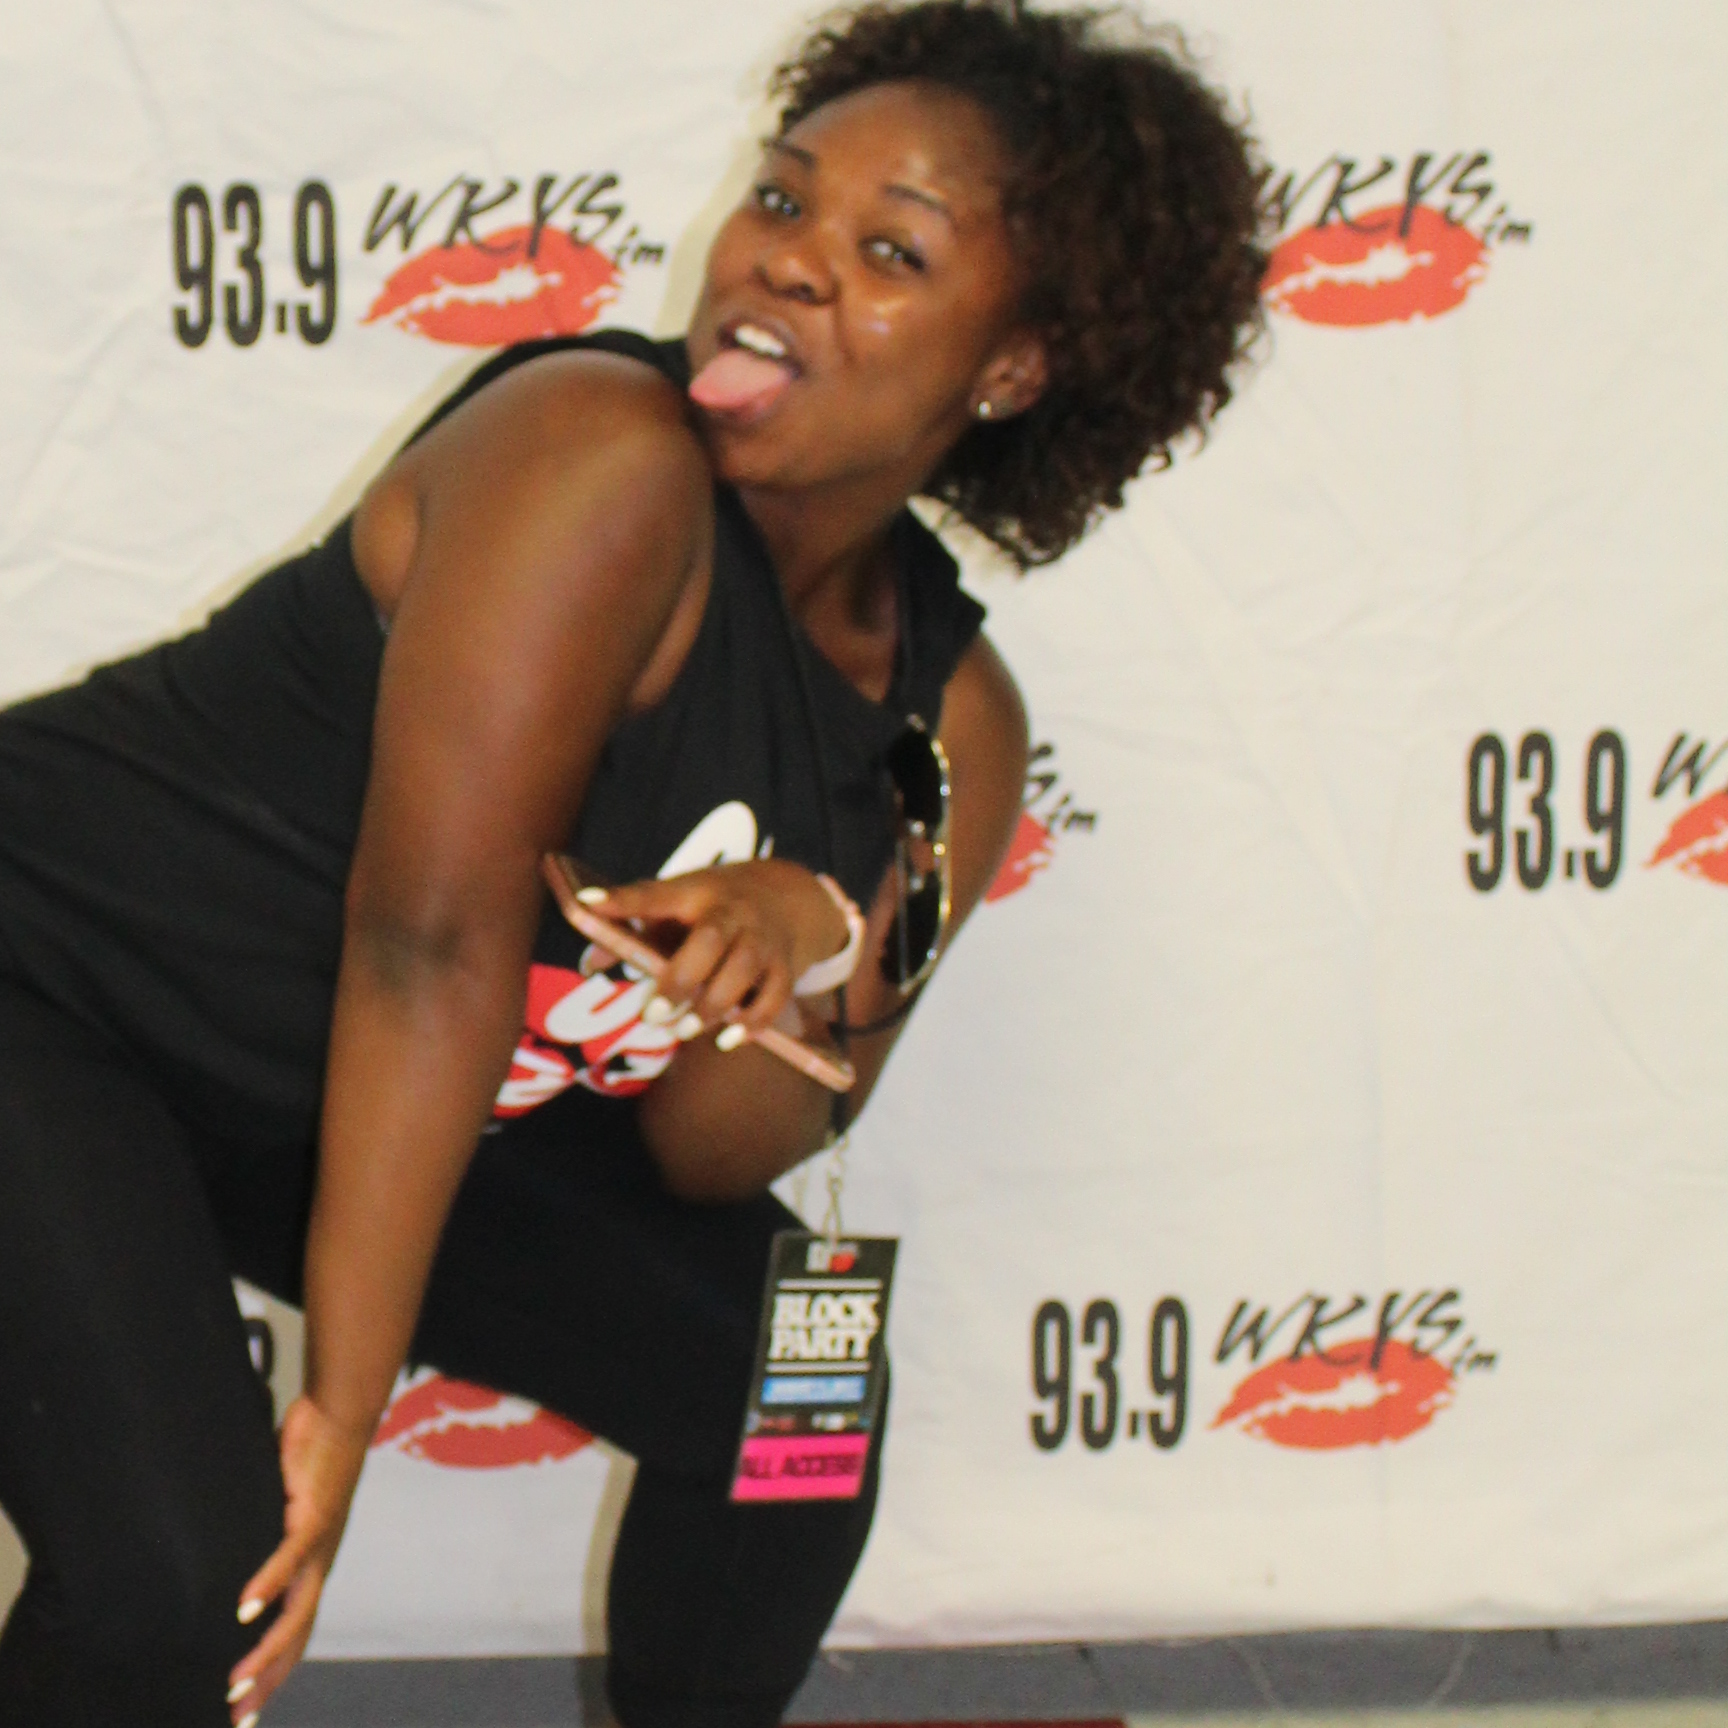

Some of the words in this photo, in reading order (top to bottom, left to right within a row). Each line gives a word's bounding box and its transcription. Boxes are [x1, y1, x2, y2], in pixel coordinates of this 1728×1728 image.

[171, 178, 339, 350] 93.9
[364, 173, 624, 259] WKYS
[1466, 728, 1628, 894] 93.9
[769, 1327, 876, 1360] PARTY
[772, 1292, 880, 1328] BLOCK
[1029, 1295, 1191, 1454] 93.9
[1215, 1289, 1463, 1372] WKYS
[782, 1452, 857, 1477] ACCESS
